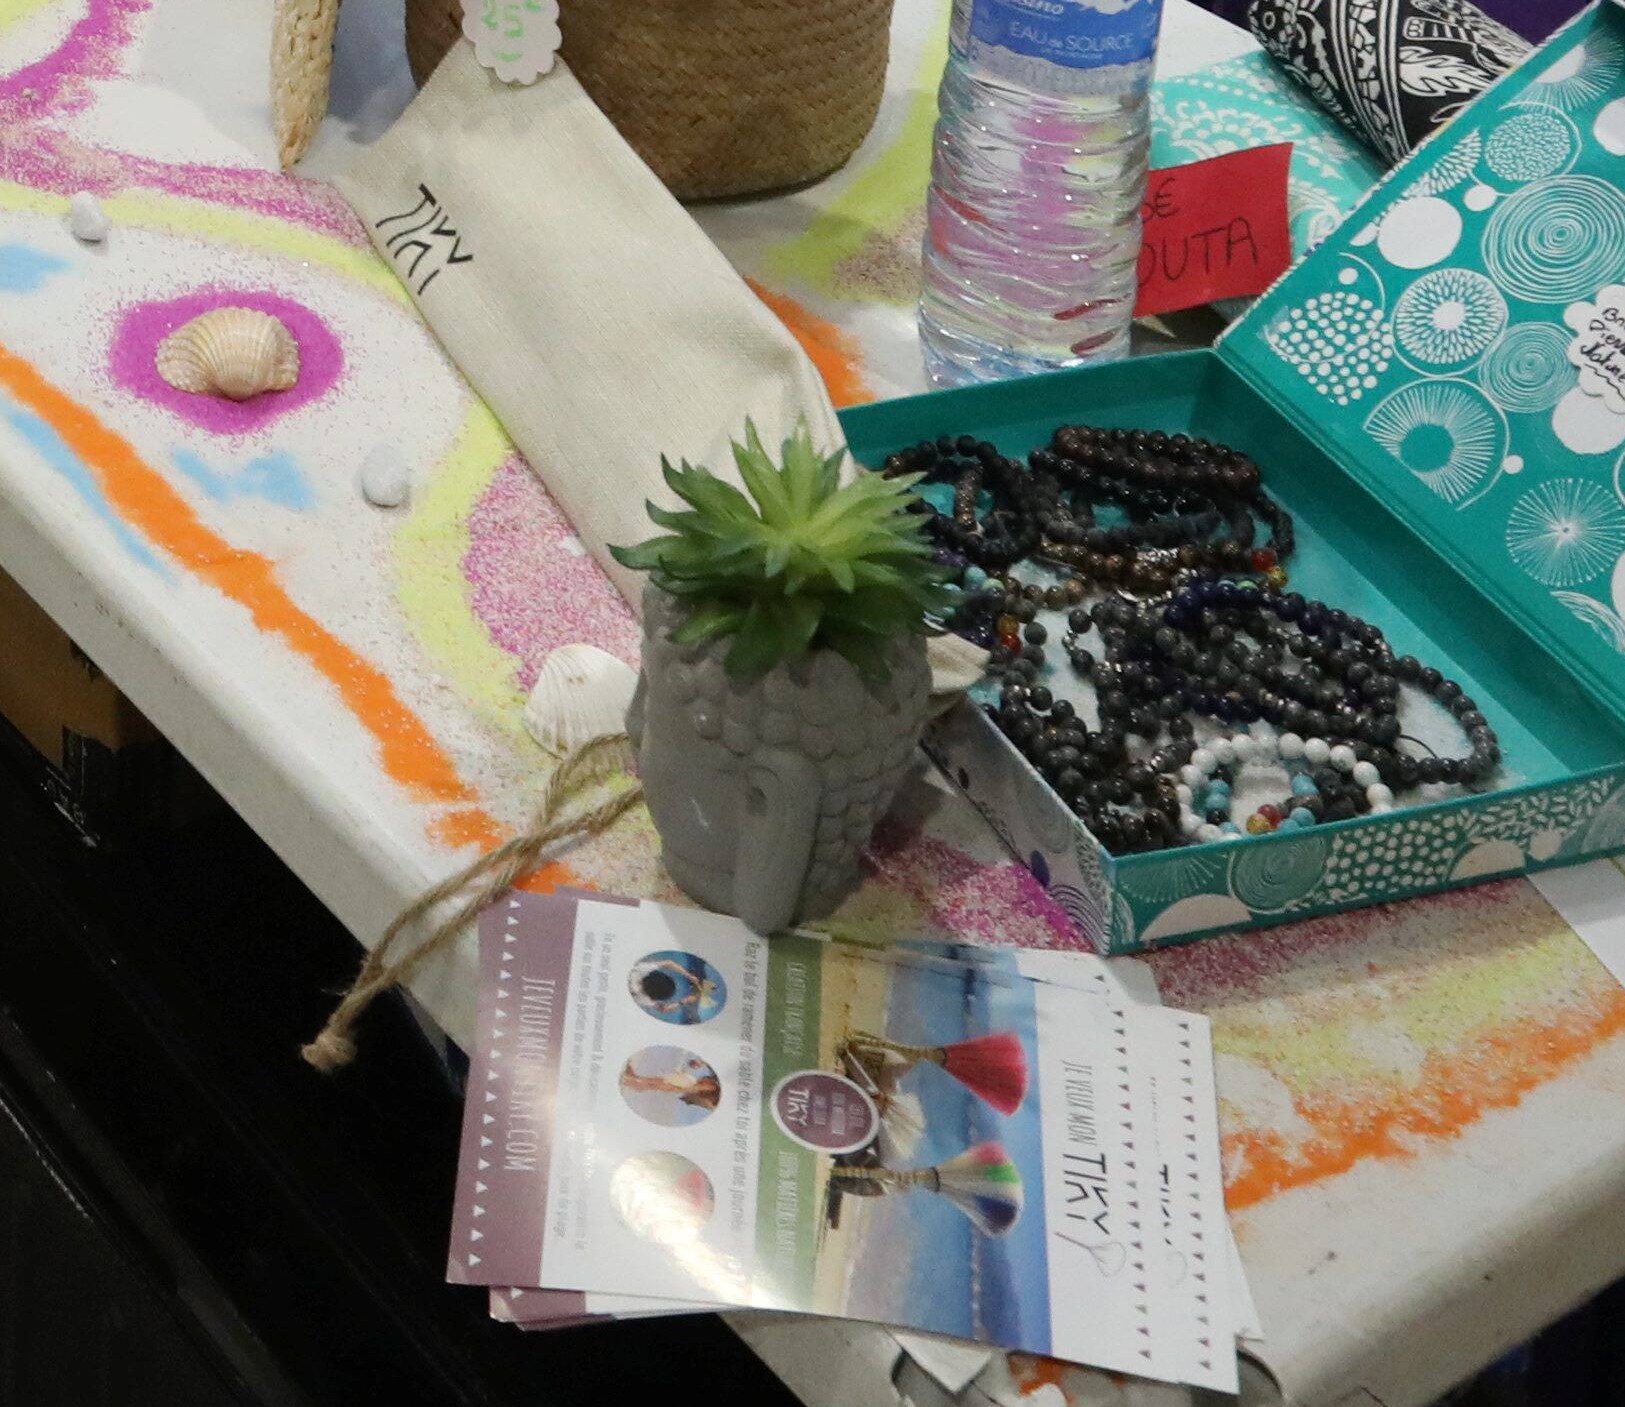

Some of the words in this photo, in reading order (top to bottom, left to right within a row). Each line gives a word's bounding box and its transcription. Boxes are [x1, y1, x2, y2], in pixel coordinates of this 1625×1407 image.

[1009, 21, 1049, 46] EAU
[1064, 32, 1134, 53] SOURCE
[375, 183, 474, 296] TIKY
[787, 1087, 810, 1128] TIKY
[1064, 1078, 1095, 1112] VEUX
[1067, 1112, 1098, 1147] MON
[1062, 1152, 1111, 1235] TIKY
